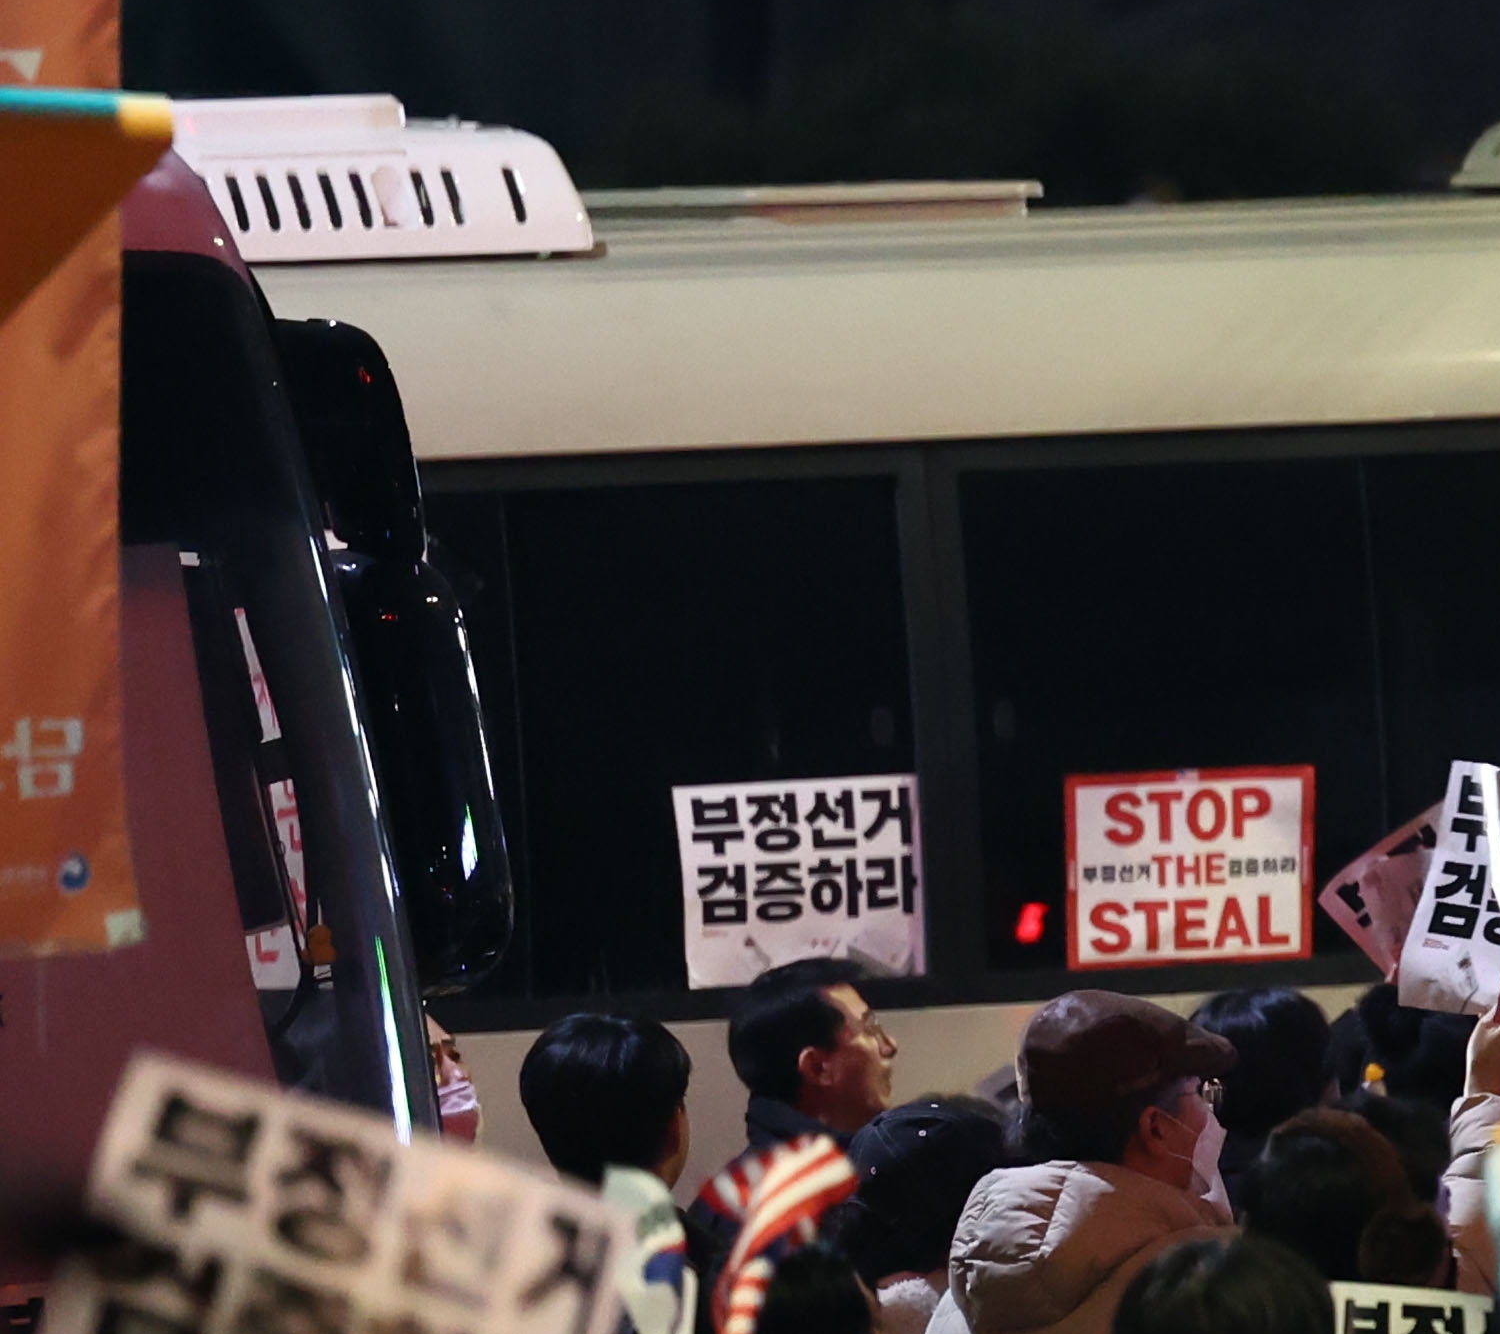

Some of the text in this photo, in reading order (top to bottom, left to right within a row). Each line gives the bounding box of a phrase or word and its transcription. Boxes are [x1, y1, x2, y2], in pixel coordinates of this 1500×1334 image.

[691, 787, 915, 856] 부정선거
[1104, 787, 1273, 846] STOP
[696, 855, 918, 928] 검증하라
[1082, 863, 1151, 884] 부정선거
[1151, 853, 1226, 886] THE
[1089, 897, 1291, 955] STEAL
